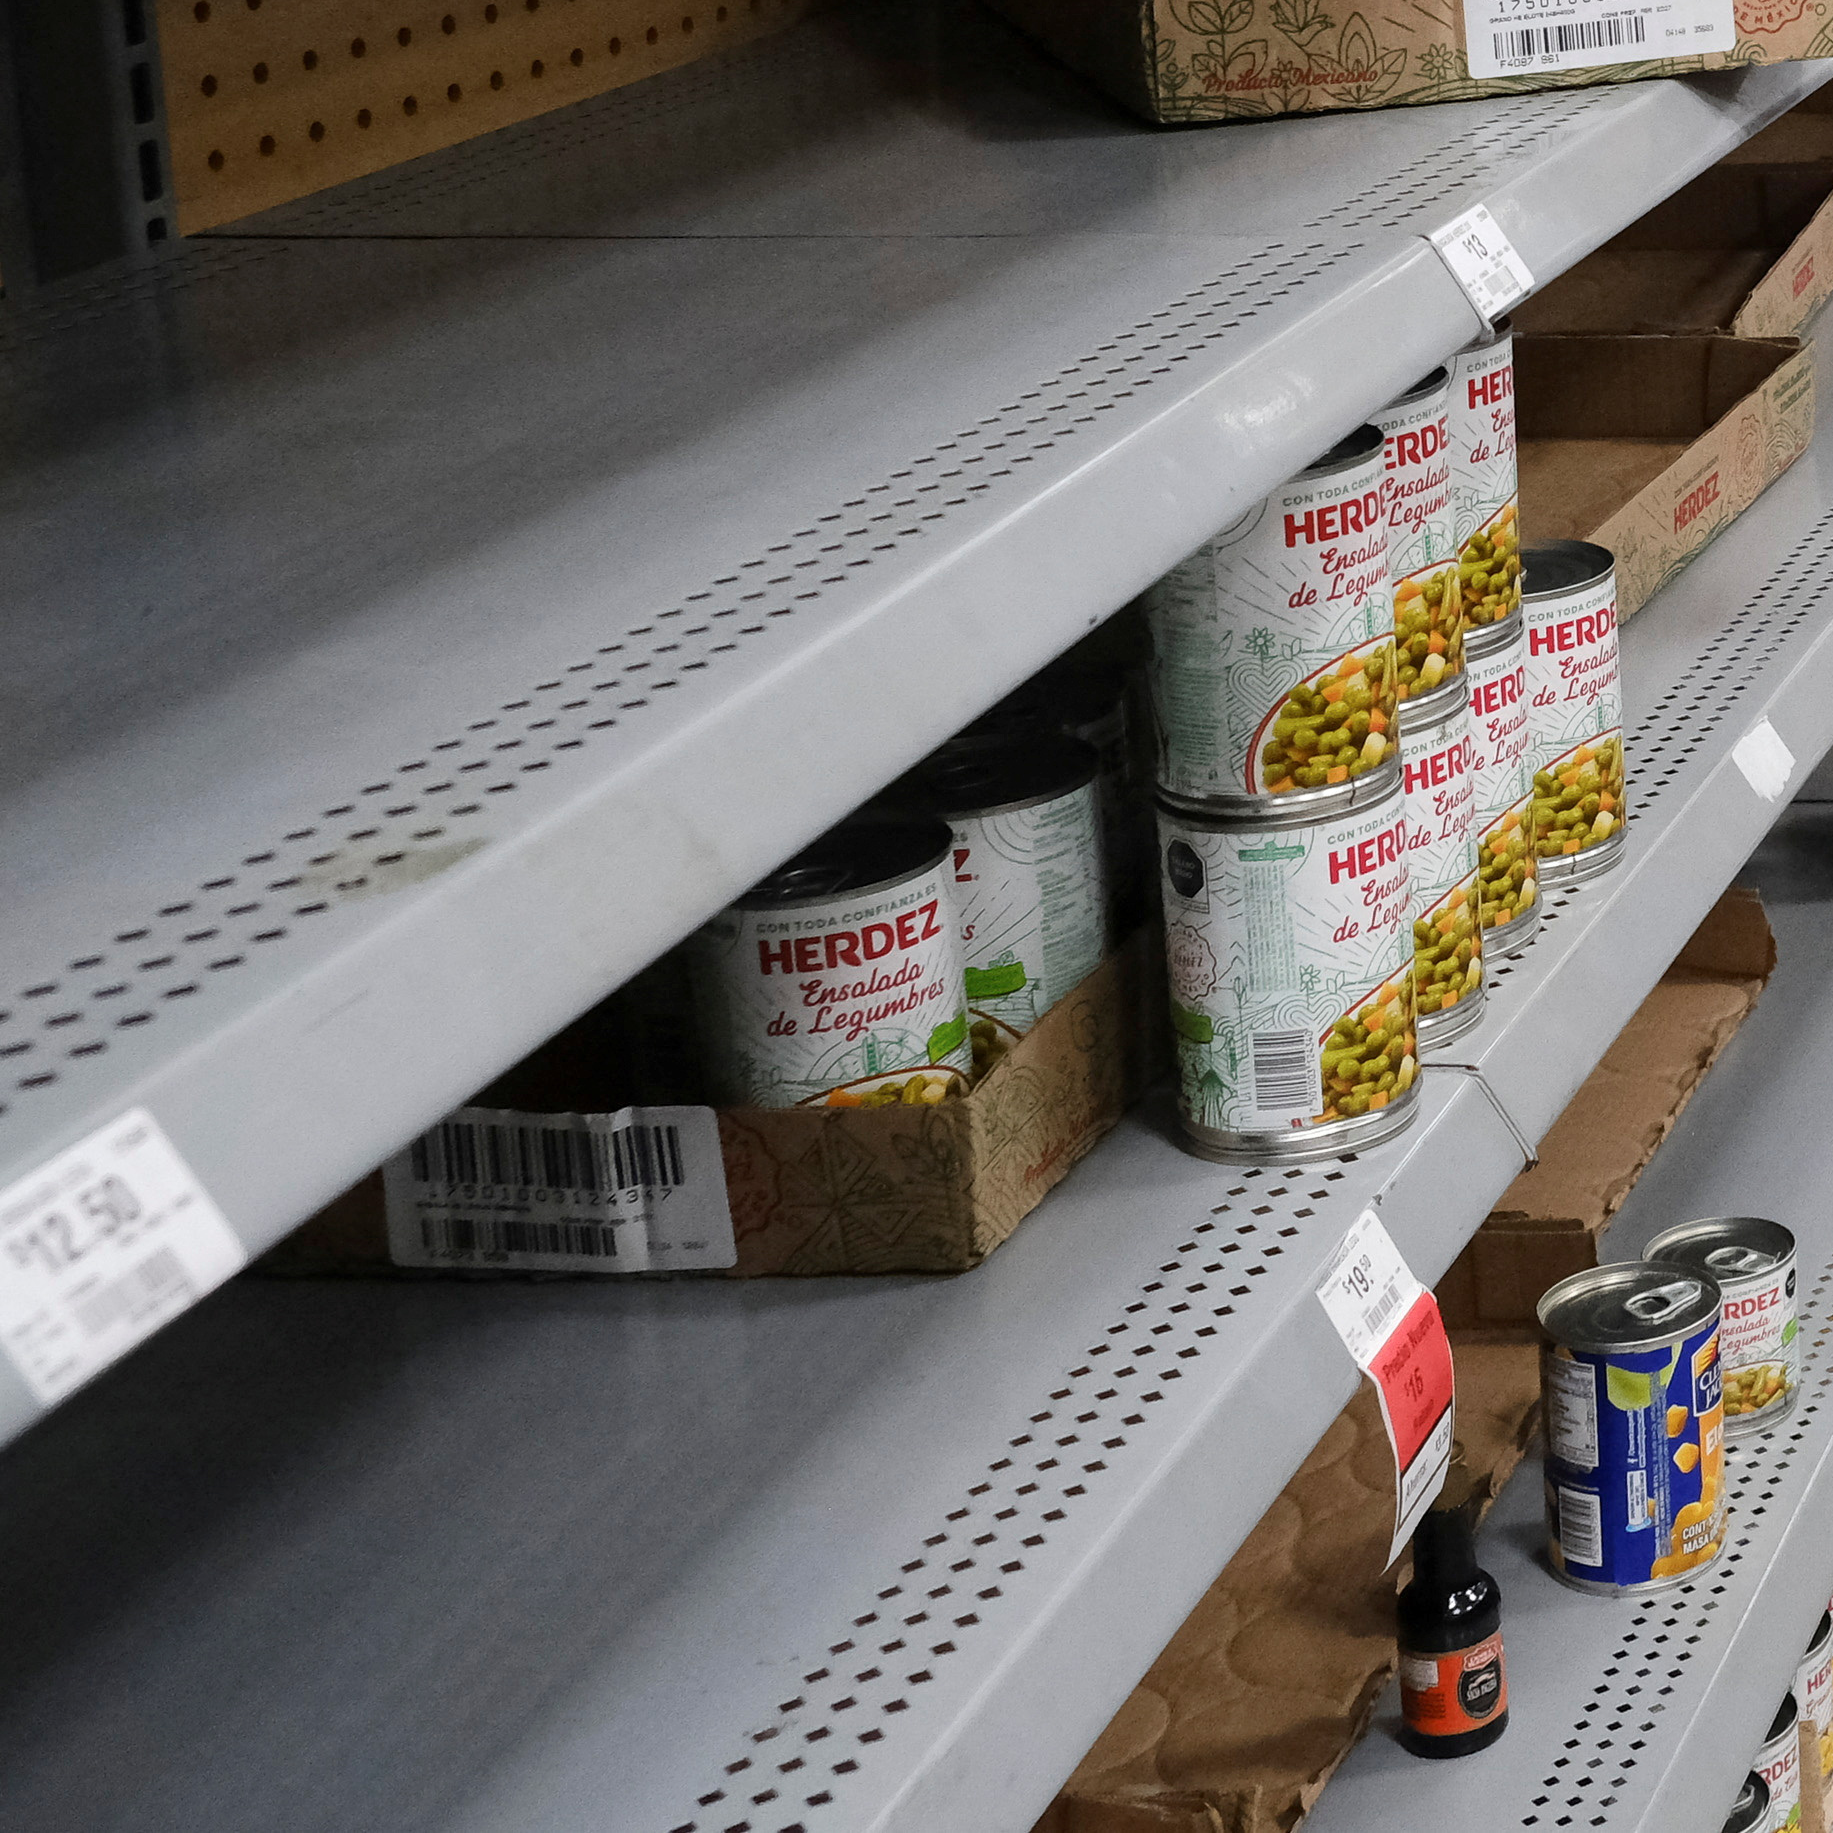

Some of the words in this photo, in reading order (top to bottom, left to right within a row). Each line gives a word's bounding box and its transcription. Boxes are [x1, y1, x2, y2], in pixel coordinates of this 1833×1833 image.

[1202, 69, 1284, 94] Producto
[1288, 66, 1378, 88] Mexicano
[1468, 365, 1513, 410] HER
[1385, 413, 1450, 470] ERDE
[1470, 439, 1490, 464] de
[1283, 493, 1314, 508] CON
[1317, 484, 1350, 501] TODA
[1283, 486, 1388, 549] HERDE
[1673, 469, 1721, 535] HERDEZ
[1319, 526, 1389, 575] Ensalad
[1288, 580, 1318, 608] de
[1326, 558, 1389, 607] Legum
[1528, 609, 1554, 623] CON
[1557, 603, 1584, 618] TODA
[1529, 599, 1617, 657] HERDE
[1559, 636, 1618, 679] Ensalad
[1469, 665, 1525, 717] HERD
[1532, 684, 1557, 707] de
[1563, 664, 1618, 706] Legum
[1402, 741, 1428, 757] CON
[1403, 734, 1472, 795] HERD
[1327, 831, 1354, 845] CON
[1357, 821, 1385, 837] TODA
[1328, 817, 1407, 886] HERD
[1408, 824, 1432, 851] de
[756, 921, 790, 934] CON
[795, 918, 837, 930] TODA
[841, 892, 924, 923] CONFIANZA
[925, 883, 937, 895] ES
[1333, 916, 1359, 944] de
[758, 899, 942, 976] HERDEZ
[800, 956, 925, 1007] Ensalada
[767, 1010, 798, 1037] de
[807, 977, 945, 1042] Legumbres
[1722, 1287, 1780, 1320] RDEZ
[1683, 1534, 1709, 1554] MASA
[1807, 1657, 1832, 1695] HER
[1758, 1743, 1798, 1786] RDEZ
